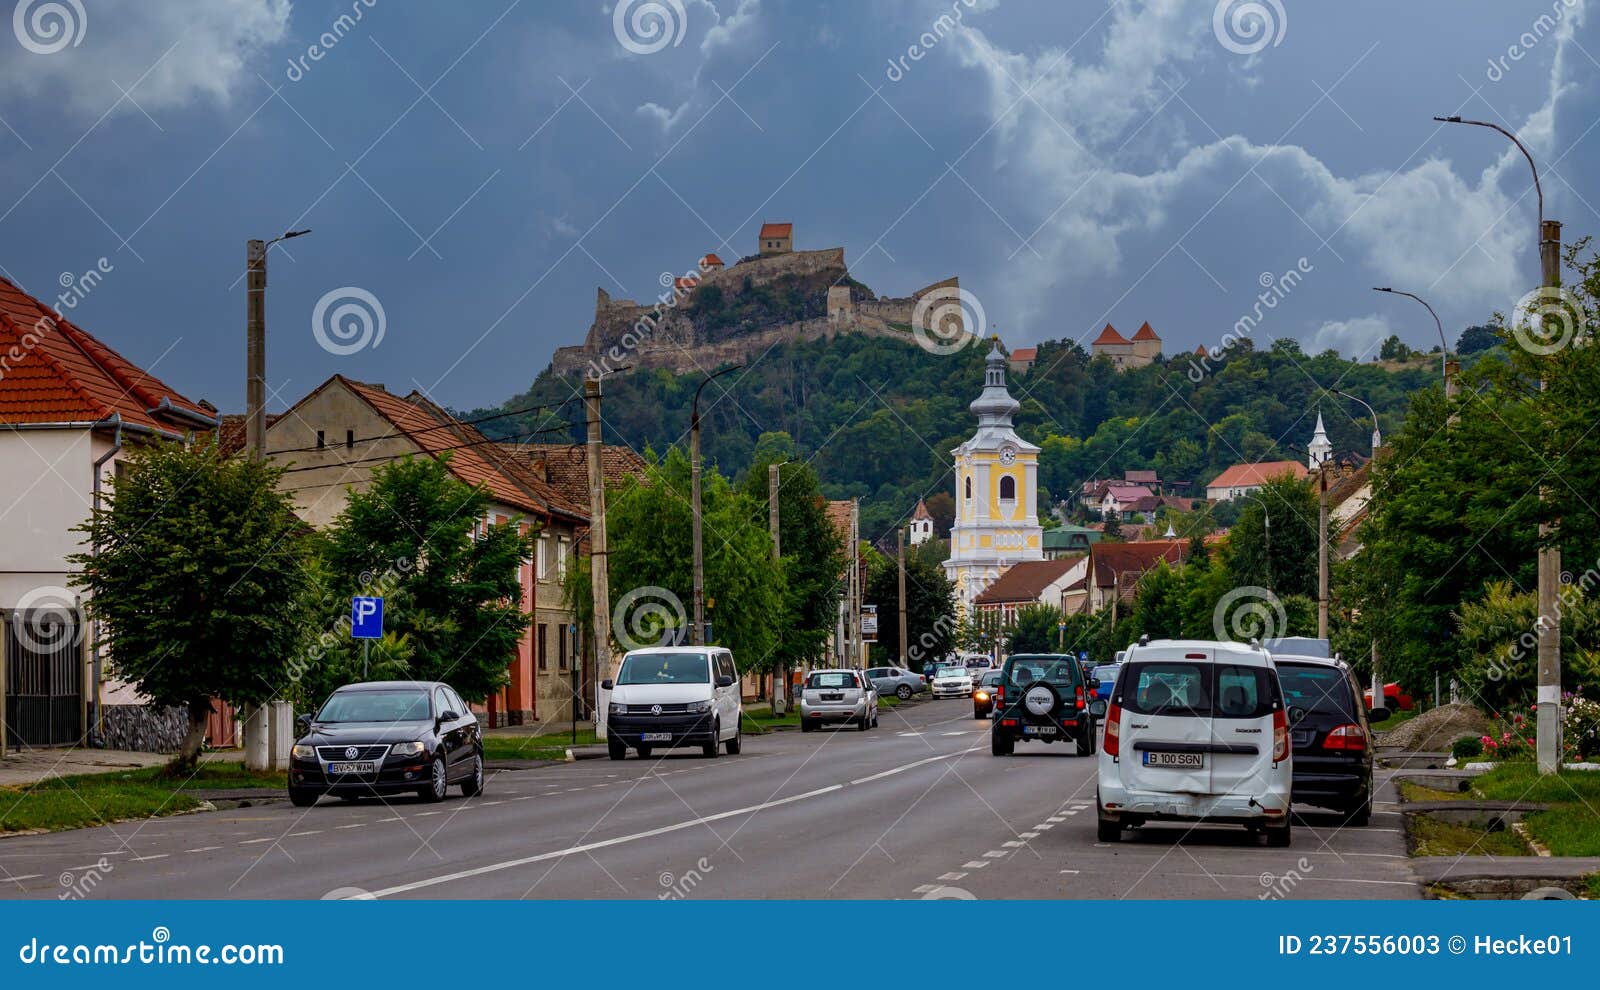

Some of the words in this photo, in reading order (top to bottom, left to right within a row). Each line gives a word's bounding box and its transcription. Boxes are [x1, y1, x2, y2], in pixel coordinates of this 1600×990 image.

[359, 600, 377, 626] P
[1150, 754, 1157, 763] B
[1161, 754, 1176, 764] 100
[1178, 754, 1201, 765] SGN
